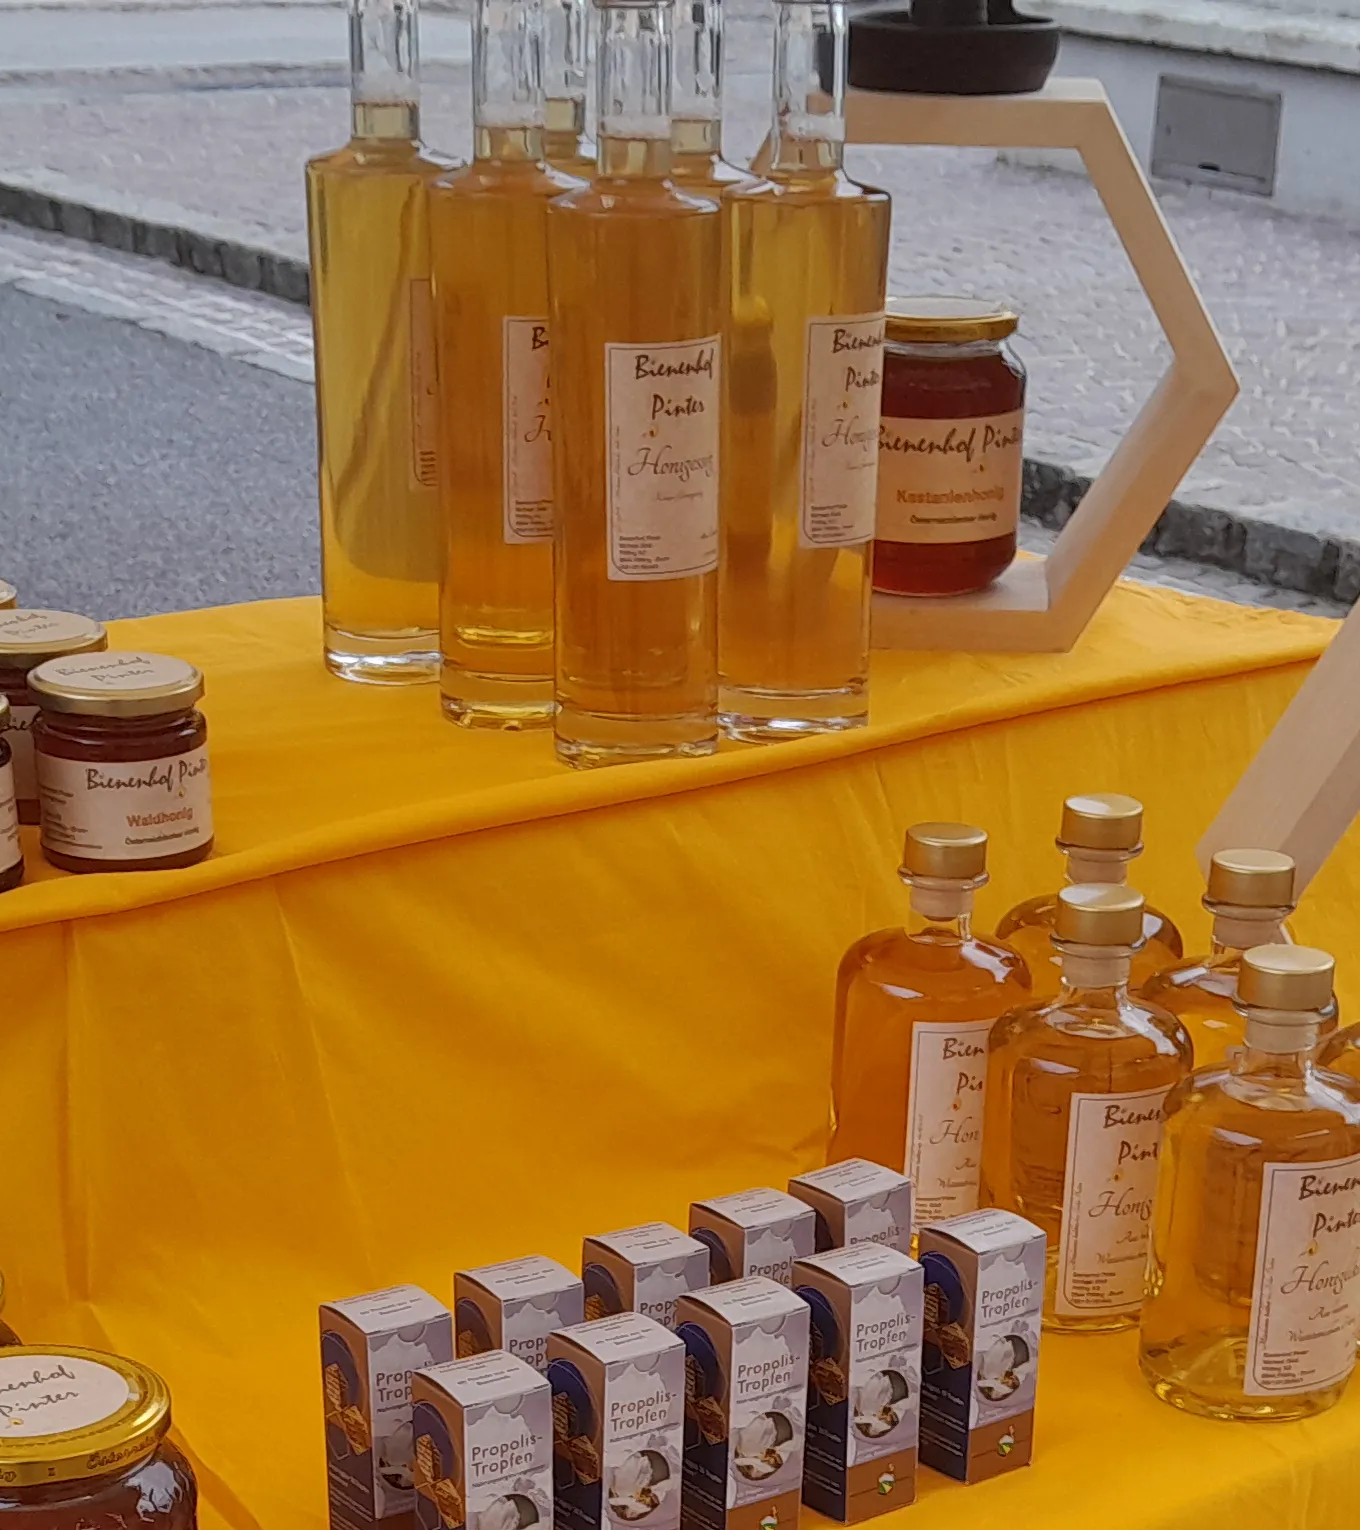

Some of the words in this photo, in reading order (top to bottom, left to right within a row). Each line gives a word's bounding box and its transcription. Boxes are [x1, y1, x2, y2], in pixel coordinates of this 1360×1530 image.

[635, 348, 714, 380] Bienenhof
[652, 395, 705, 420] Pinter
[86, 765, 172, 791] Bienenhof
[127, 807, 193, 828] Waldhonig
[981, 1279, 1039, 1305] Propolis-
[981, 1294, 1030, 1320] Tropfen
[857, 1313, 916, 1337] Propolis-
[856, 1331, 906, 1352] Tropfen
[737, 1355, 801, 1379] Propolis-
[737, 1371, 791, 1395] Tropfen
[611, 1391, 677, 1417] Propolis-
[611, 1409, 666, 1432] Tropfen
[472, 1435, 542, 1461] Propolis-
[472, 1453, 532, 1477] Tropfen
